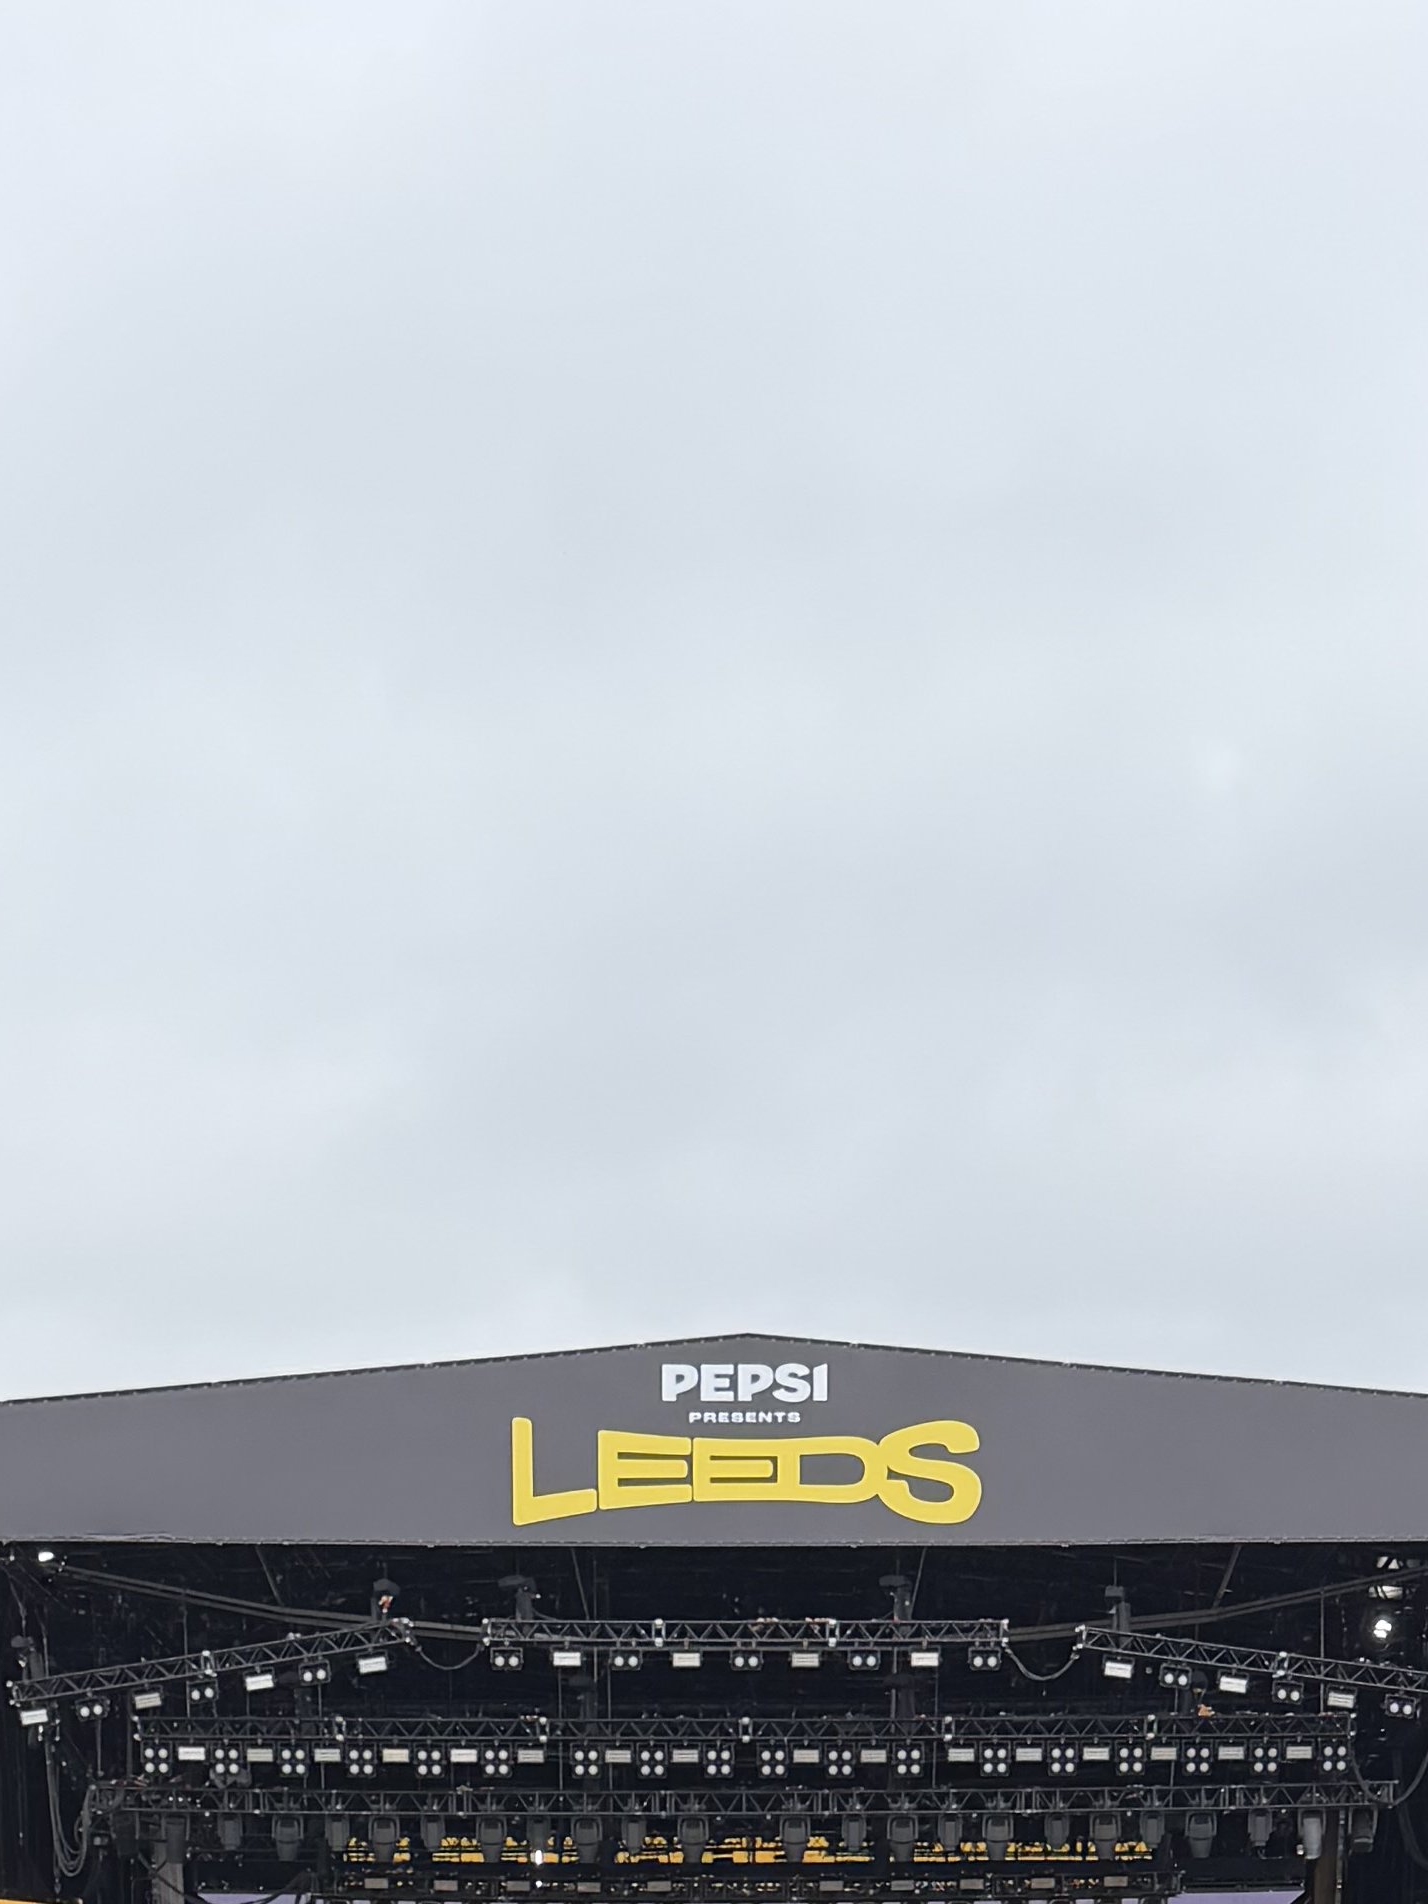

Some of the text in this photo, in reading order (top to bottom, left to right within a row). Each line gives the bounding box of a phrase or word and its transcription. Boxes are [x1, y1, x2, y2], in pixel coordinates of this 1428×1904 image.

[662, 1363, 828, 1402] PEPSI
[689, 1411, 801, 1423] PRESENTS
[512, 1417, 981, 1525] LEEDS
